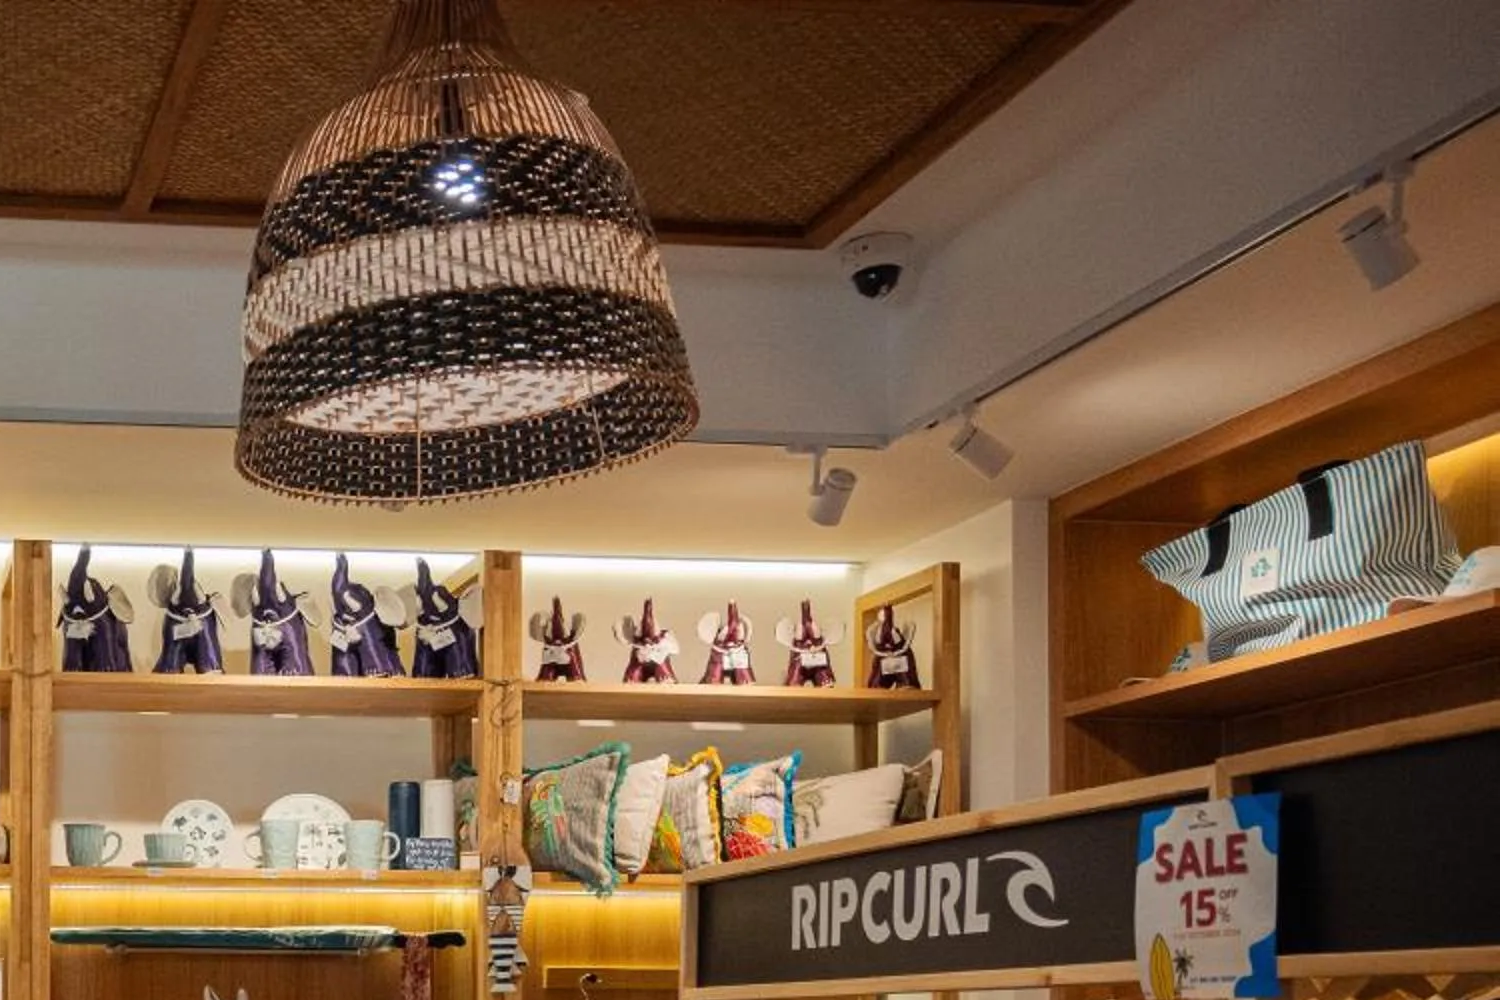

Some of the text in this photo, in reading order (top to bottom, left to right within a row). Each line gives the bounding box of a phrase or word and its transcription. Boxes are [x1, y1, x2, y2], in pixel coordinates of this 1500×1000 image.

[1155, 833, 1248, 884] SALE
[1180, 888, 1217, 928] 15
[1219, 888, 1239, 900] OFF
